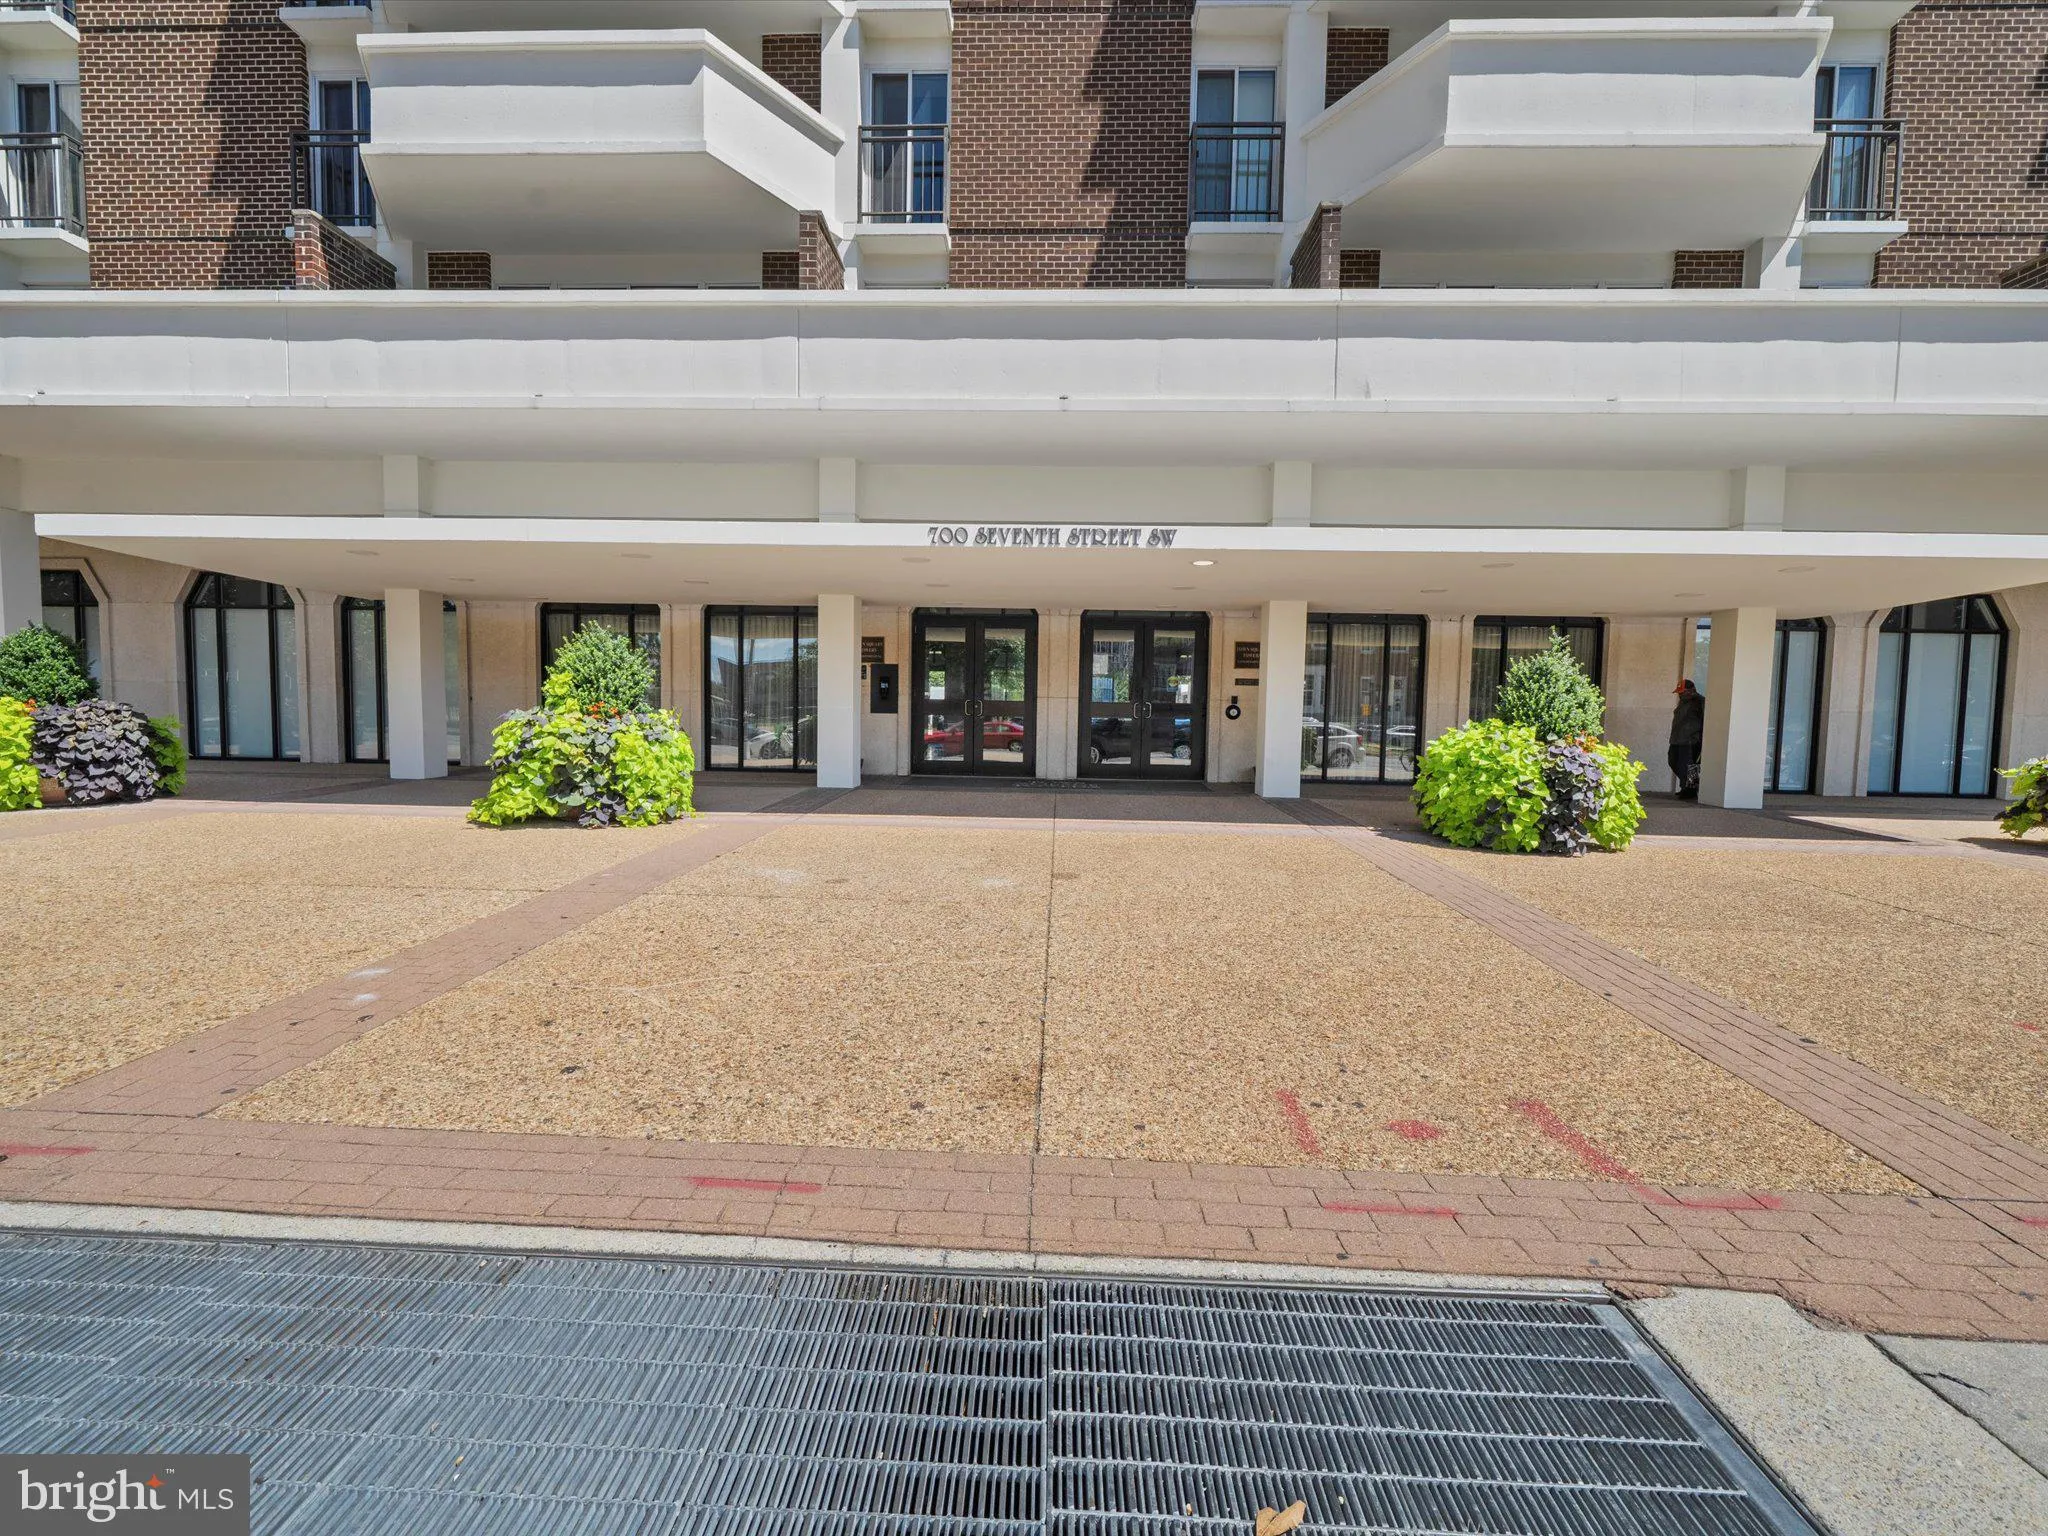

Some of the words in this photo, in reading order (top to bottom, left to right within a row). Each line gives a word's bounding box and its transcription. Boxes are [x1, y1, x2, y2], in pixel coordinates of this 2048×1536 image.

[927, 526, 969, 545] 700
[974, 526, 1061, 546] SEVENTH
[1067, 527, 1142, 546] STREET
[1147, 528, 1178, 547] SW
